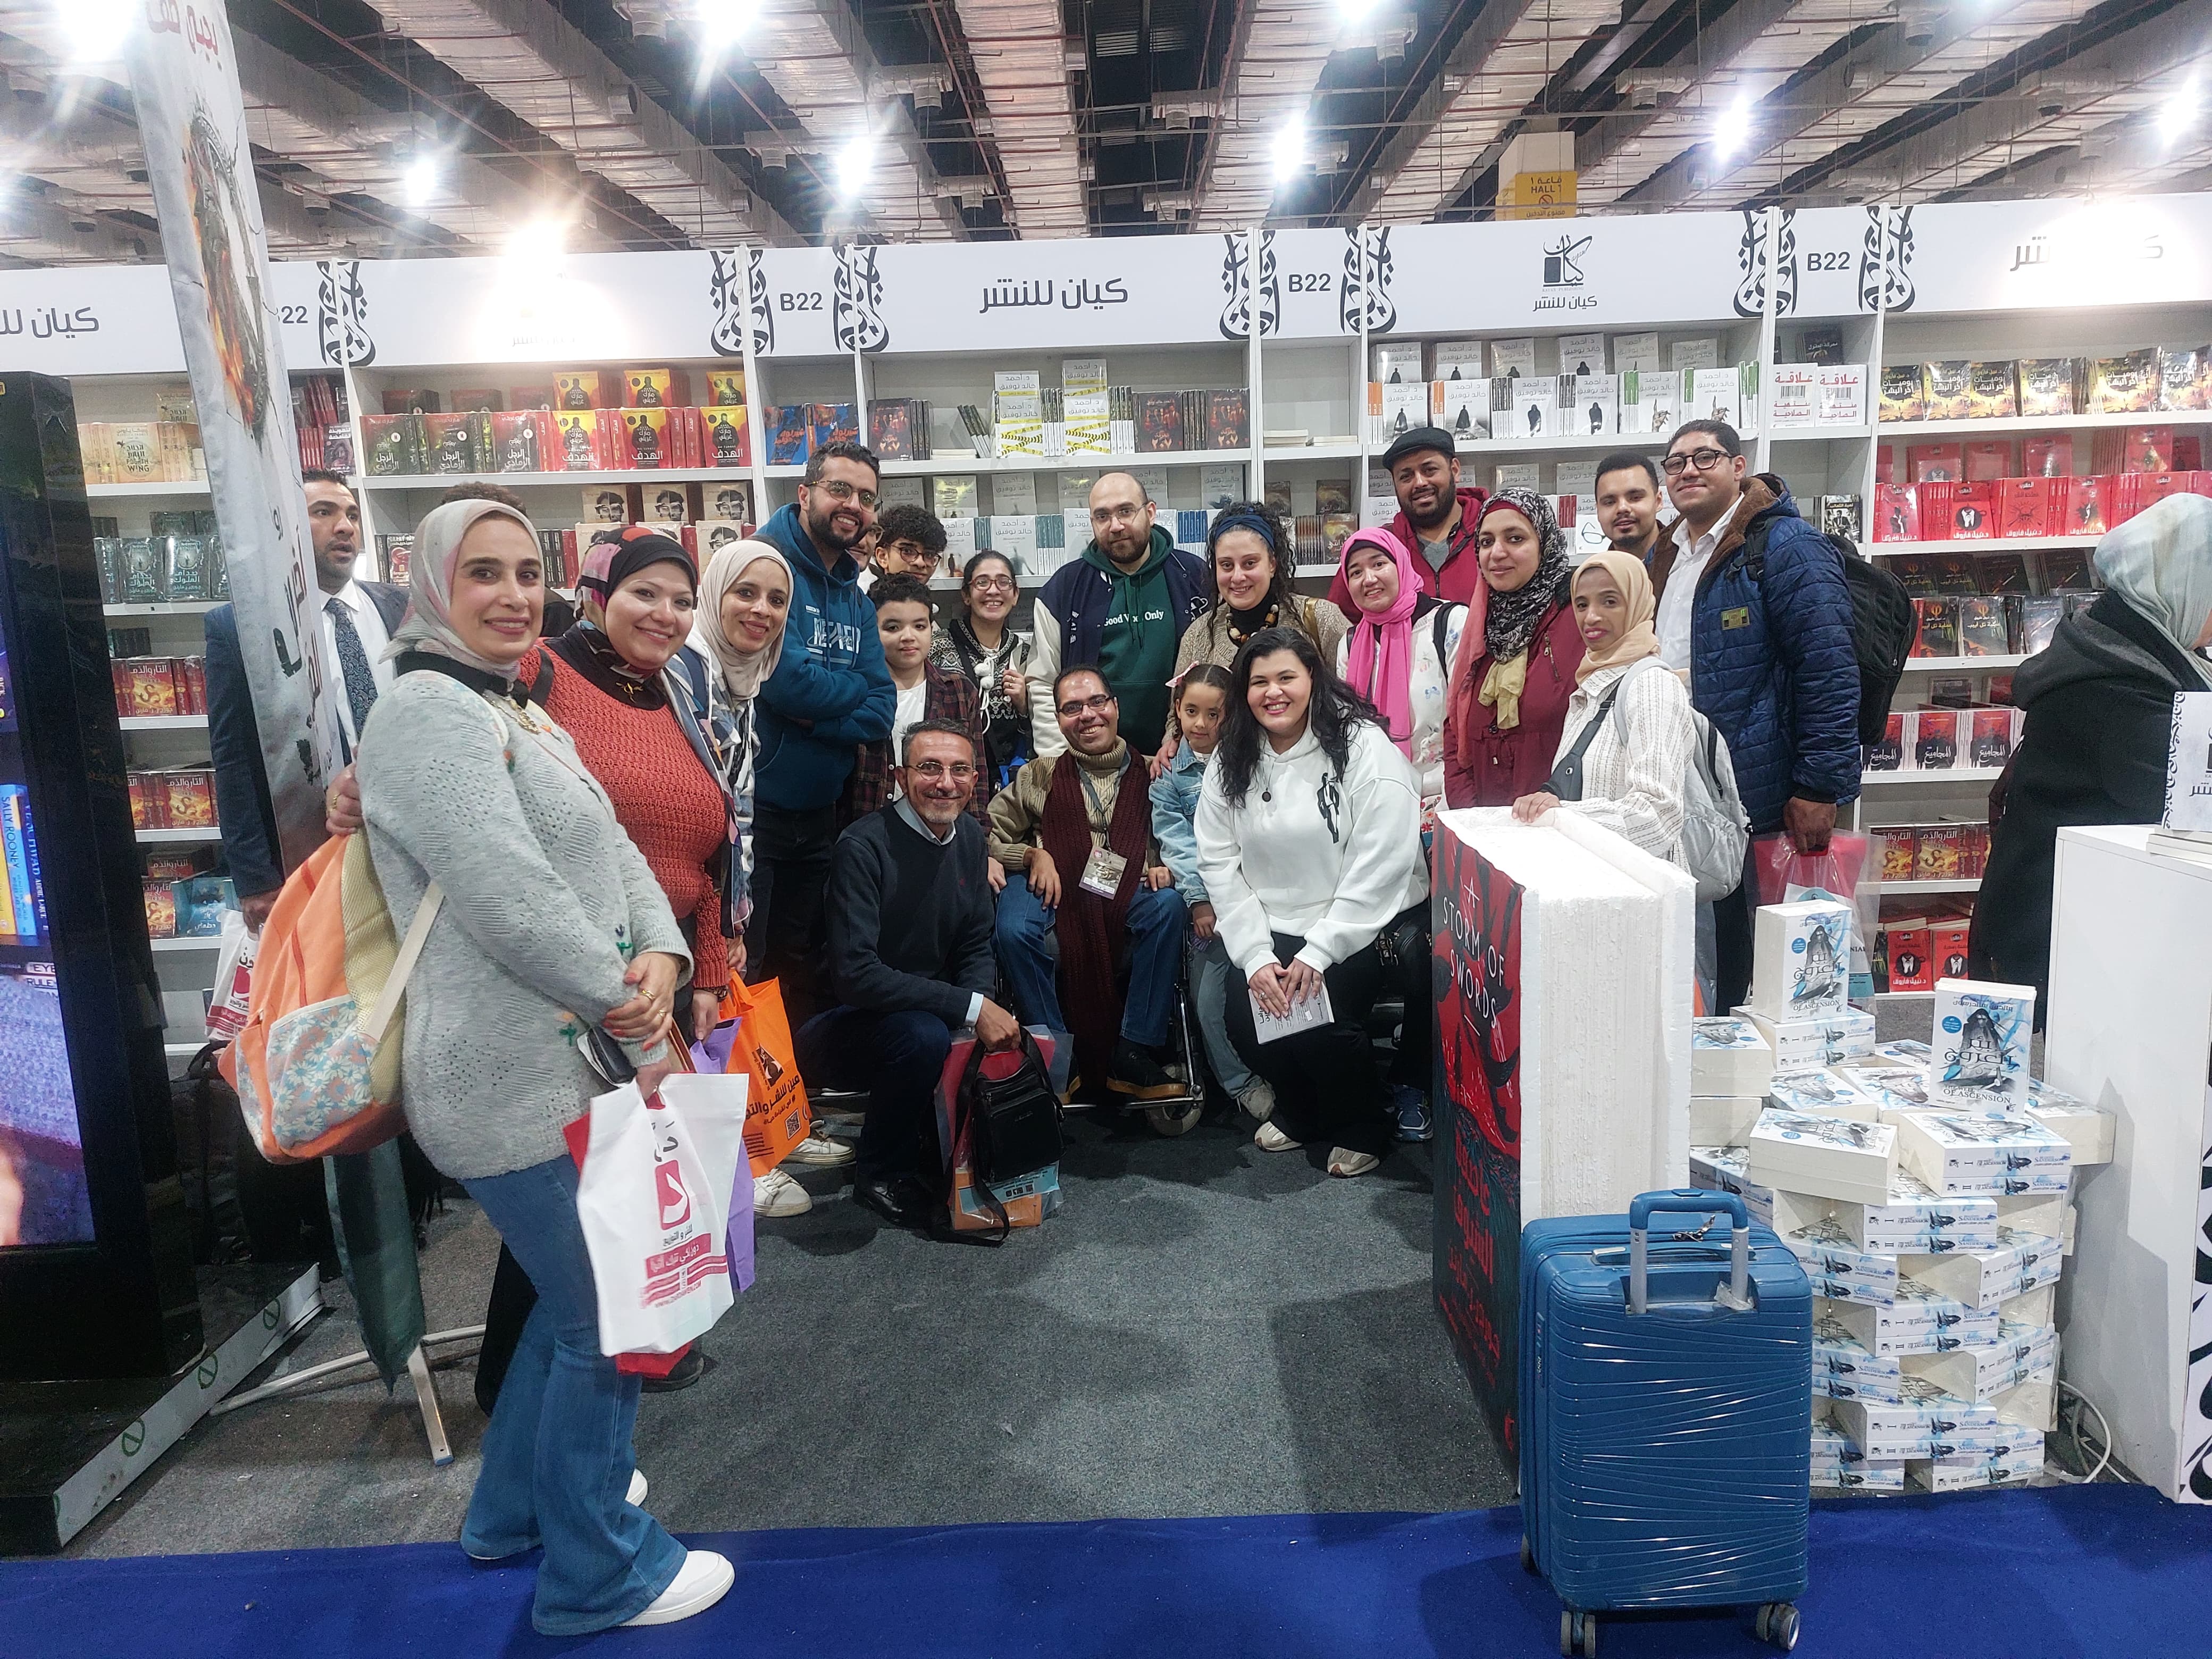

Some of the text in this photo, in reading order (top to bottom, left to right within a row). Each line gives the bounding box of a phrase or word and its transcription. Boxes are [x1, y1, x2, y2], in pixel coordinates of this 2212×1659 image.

[1531, 185, 1555, 194] HALL
[1807, 252, 1850, 272] B22
[1288, 273, 1331, 292] B22
[780, 292, 823, 312] B22
[979, 278, 1128, 314] كيان للنشر
[1532, 296, 1597, 312] كيان للنشر
[31, 307, 99, 338] كيان
[278, 306, 308, 325] 22
[1774, 372, 1813, 384] علاقة
[1820, 373, 1858, 386] علاقة
[376, 453, 393, 463] الرجل
[442, 451, 460, 461] الرجل
[562, 453, 595, 463] الهدف
[631, 450, 664, 462] الهدف
[711, 448, 743, 459] الهدف
[1145, 610, 1164, 621] Only
[1870, 748, 1897, 766] المجاميع
[1924, 745, 1951, 764] المجاميع
[1979, 744, 2005, 763] المجاميع
[5, 827, 20, 868] ROONEY
[1464, 876, 1480, 908] A
[1443, 896, 1505, 988] STORM OF
[1449, 949, 1497, 1028] SWORDS
[1803, 1000, 1840, 1010] ASCENSION
[1944, 1048, 2014, 1065] العروج
[1958, 1091, 2011, 1103] ASCENSION
